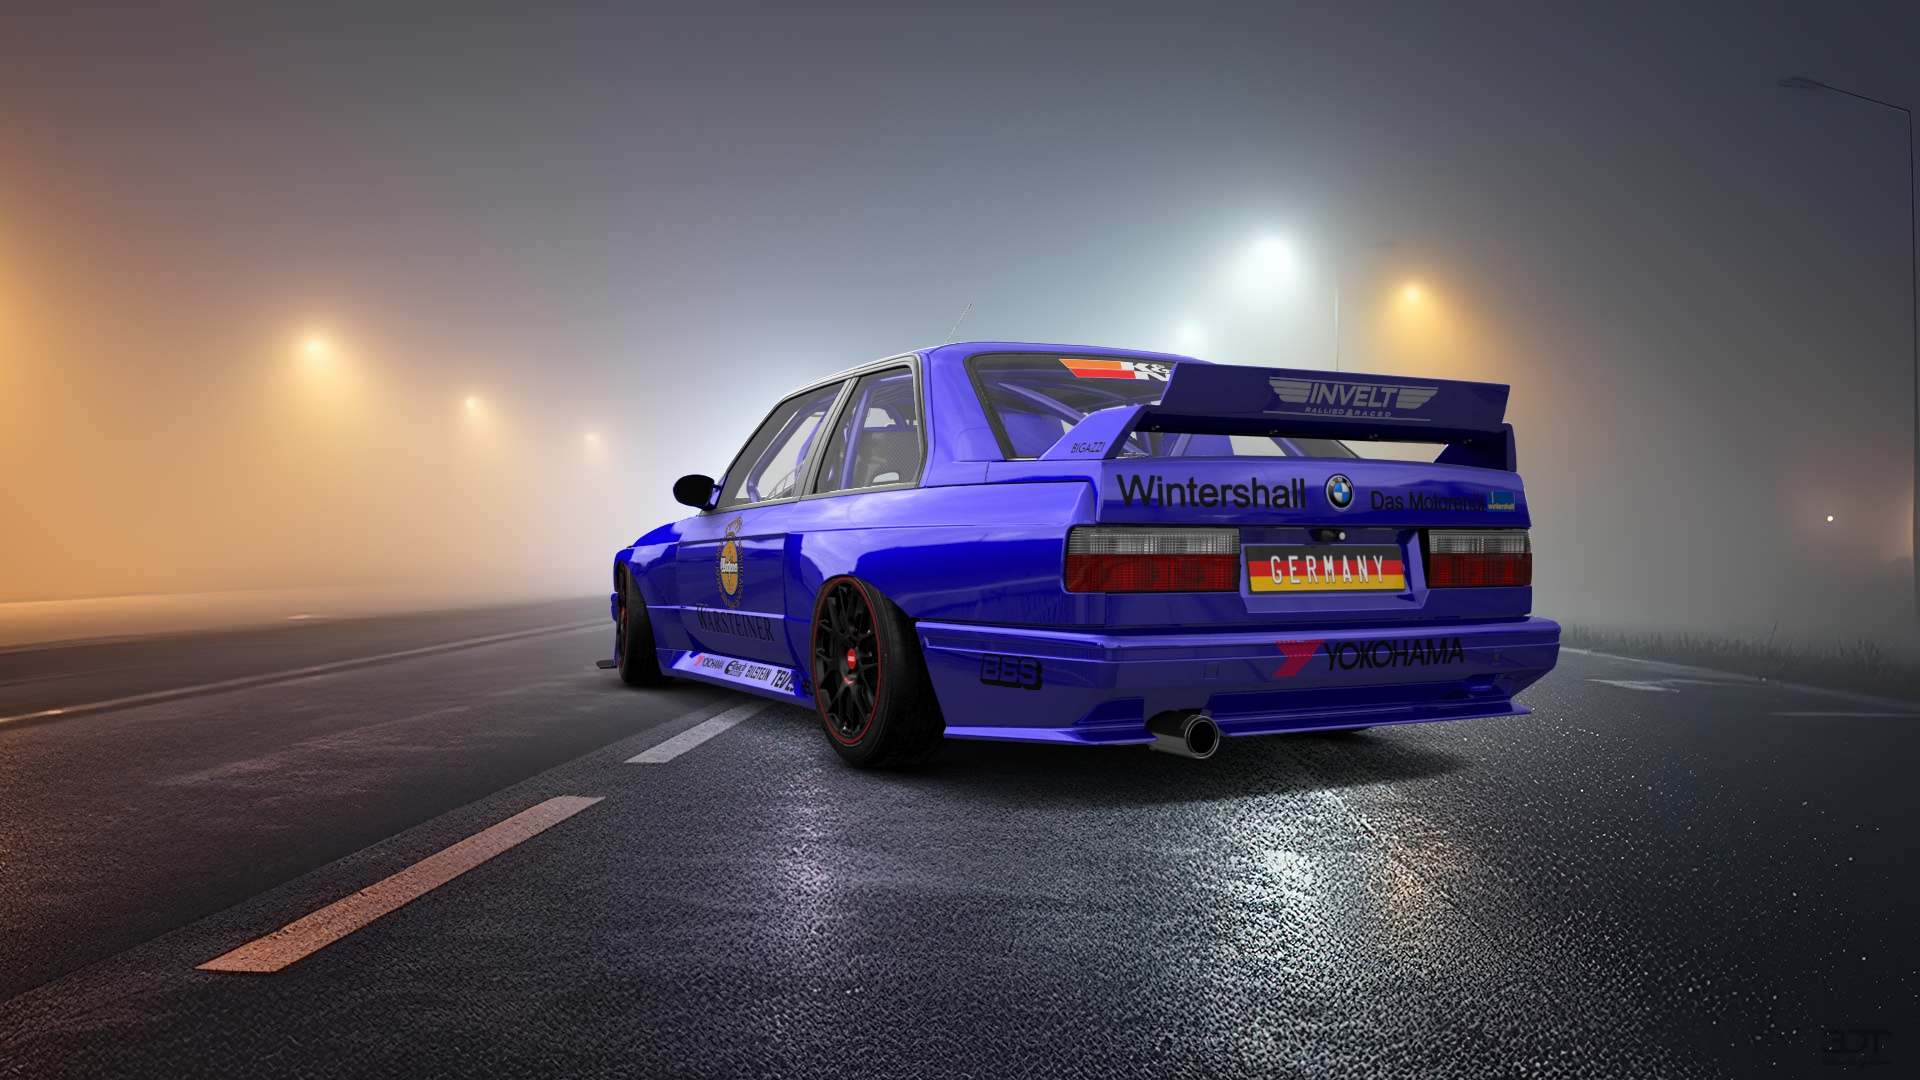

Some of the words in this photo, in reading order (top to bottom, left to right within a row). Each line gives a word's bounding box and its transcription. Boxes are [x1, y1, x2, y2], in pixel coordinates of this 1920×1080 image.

[1309, 382, 1398, 408] INVELT
[1070, 441, 1106, 454] BIGAZZI
[1117, 474, 1306, 510] Wintershall
[1371, 490, 1404, 511] Das
[1409, 491, 1485, 512] Motorenöl
[1270, 554, 1385, 586] GERMANY
[696, 603, 776, 643] WARSTEINER
[701, 656, 725, 670] YOKOHAMA
[745, 665, 772, 681] BILSTEIN
[1322, 636, 1465, 672] YOKOHAMA
[980, 653, 1043, 691] BBS
